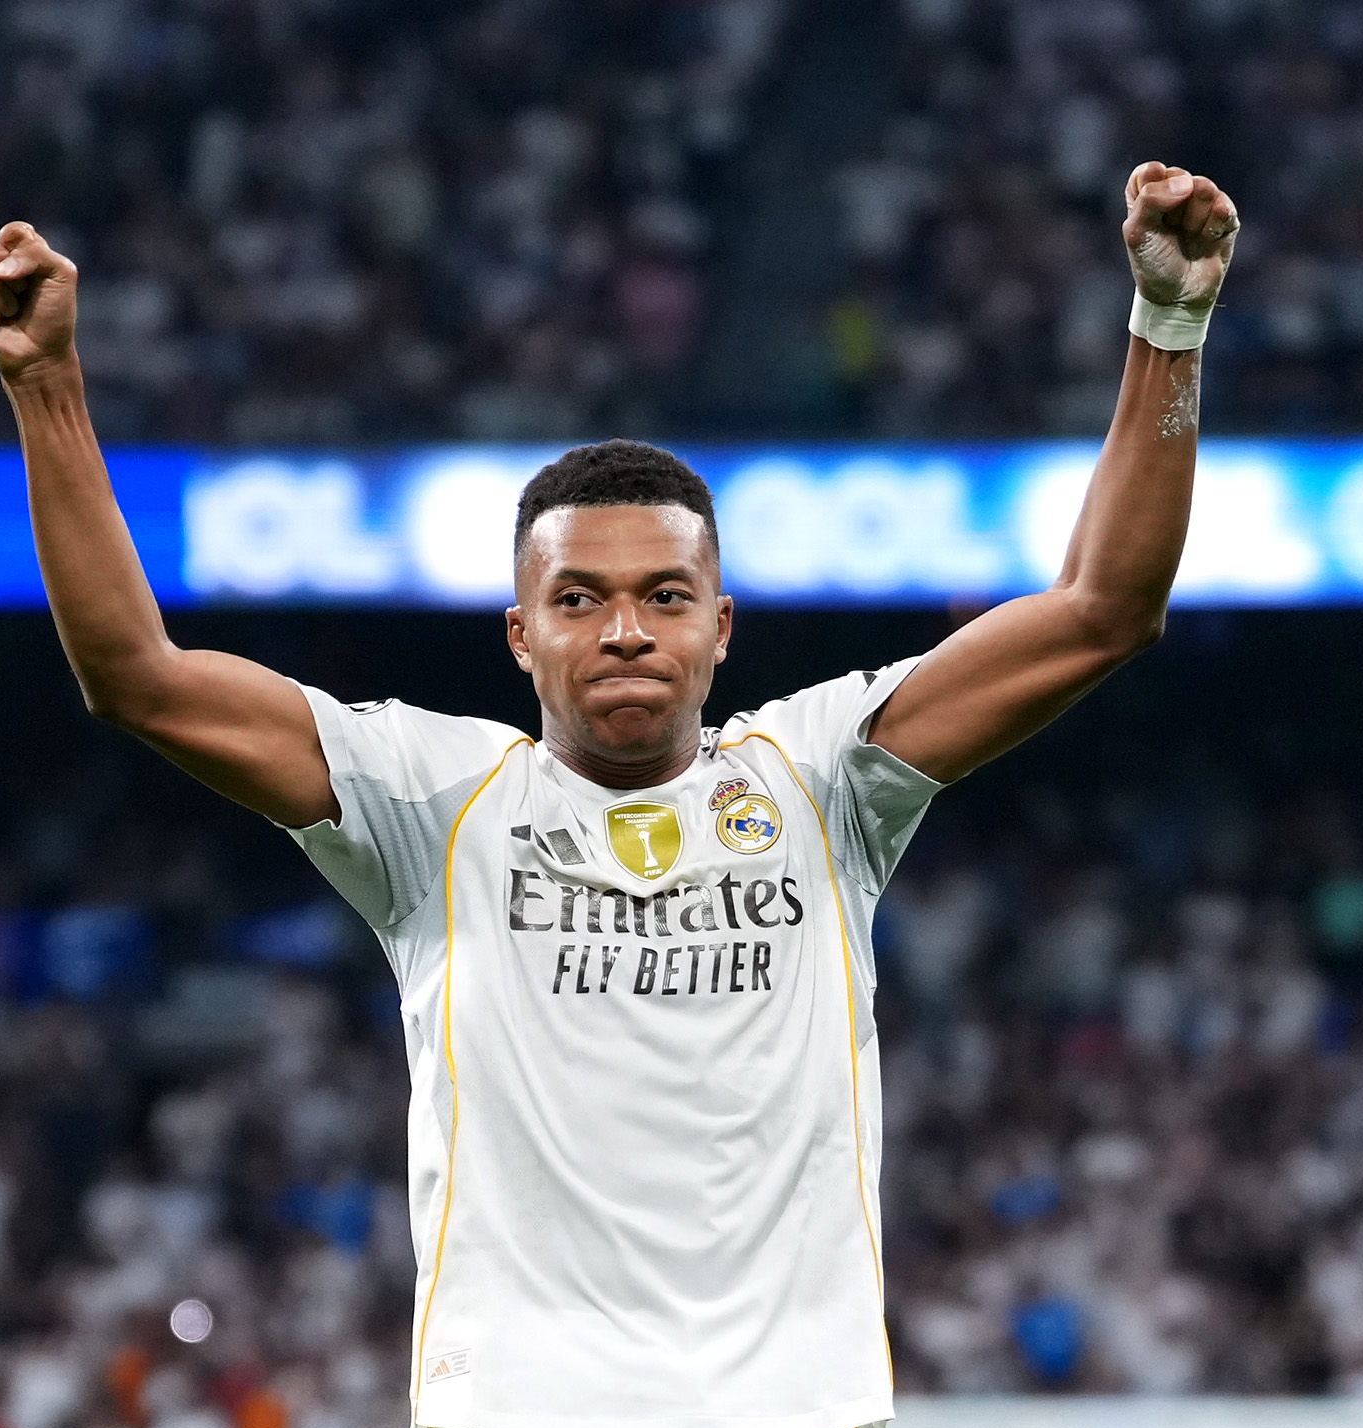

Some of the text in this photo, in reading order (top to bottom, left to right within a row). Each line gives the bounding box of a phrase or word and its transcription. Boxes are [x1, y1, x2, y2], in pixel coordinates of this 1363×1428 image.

[729, 458, 1002, 592] GOL
[510, 868, 803, 938] Emirates
[643, 868, 663, 877] FIFA
[553, 941, 773, 995] FLY BETTER
